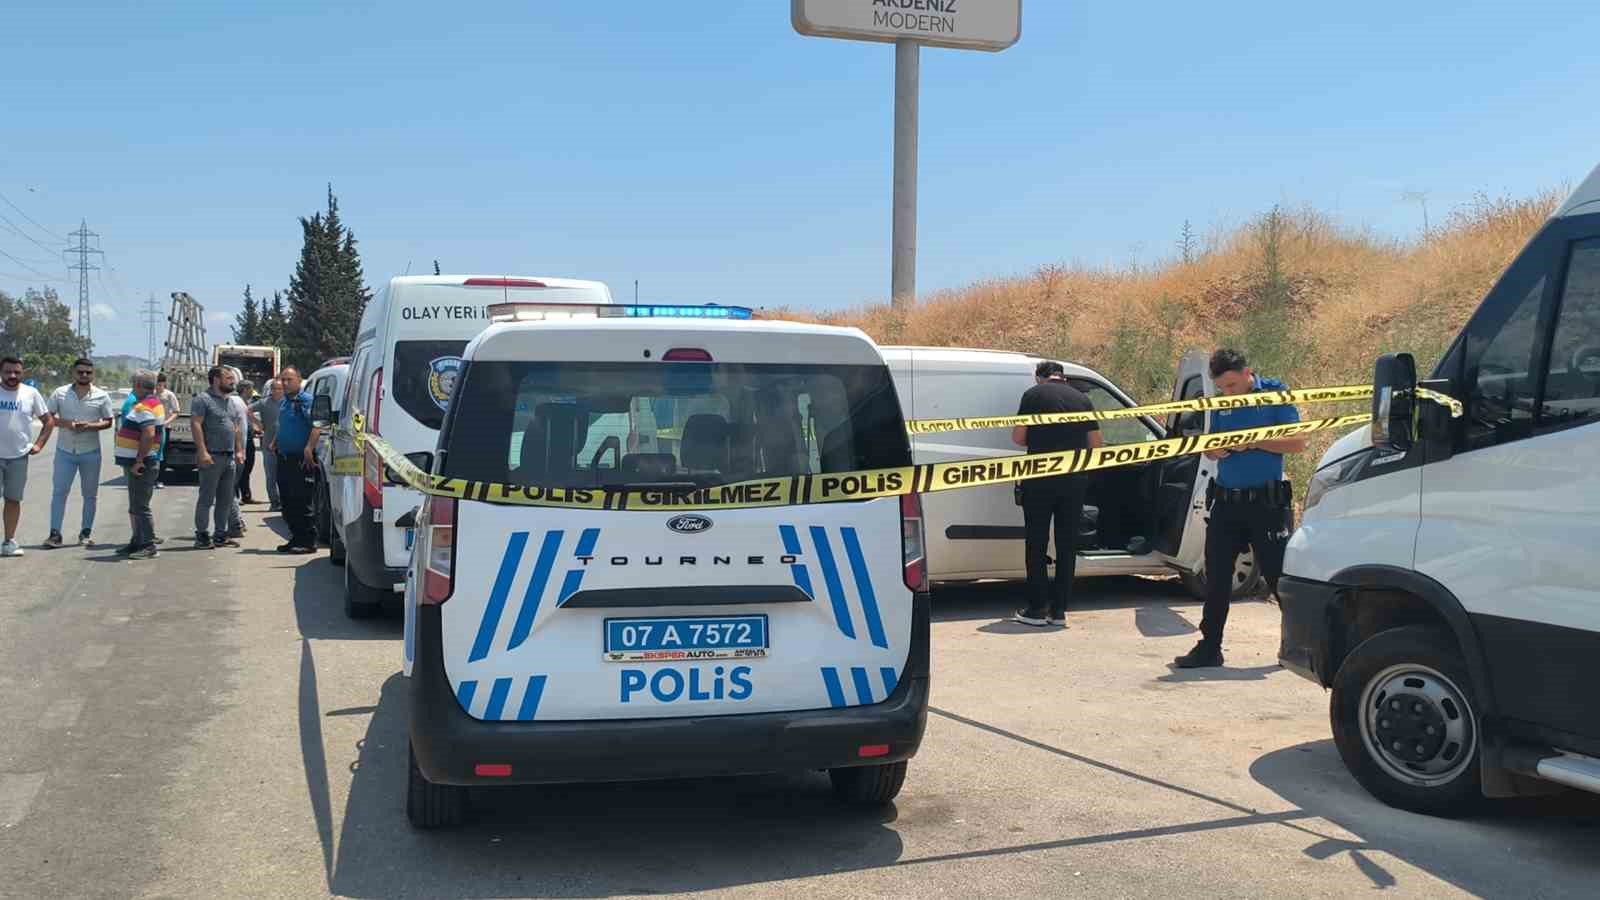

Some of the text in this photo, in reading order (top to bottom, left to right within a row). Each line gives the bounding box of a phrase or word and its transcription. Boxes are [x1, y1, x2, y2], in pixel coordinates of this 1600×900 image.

[873, 10, 955, 33] MODERN
[402, 305, 440, 320] OLAY
[821, 472, 903, 497] POLiS
[943, 456, 1066, 485] GiRiLMEZ
[576, 555, 797, 566] TOURNEO
[622, 623, 752, 647] 07 A 7572
[620, 666, 753, 703] POLiS
